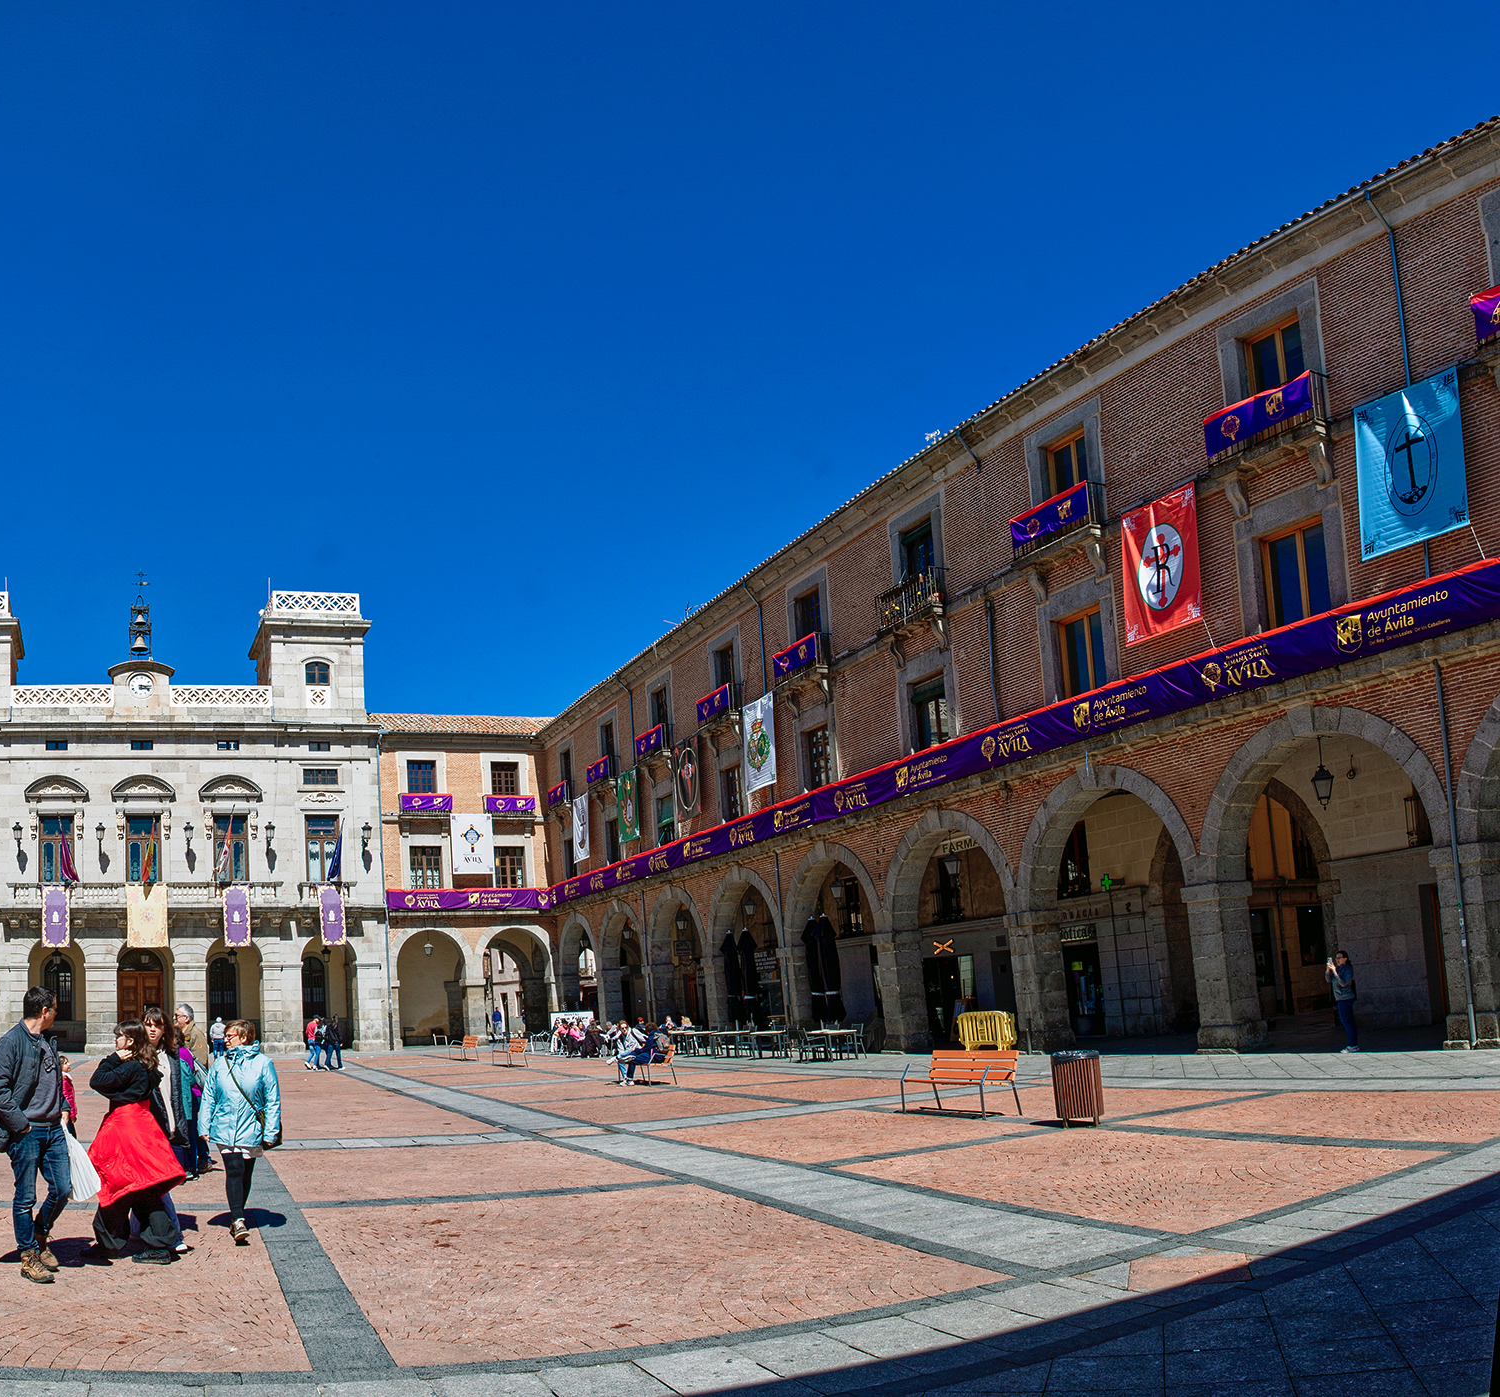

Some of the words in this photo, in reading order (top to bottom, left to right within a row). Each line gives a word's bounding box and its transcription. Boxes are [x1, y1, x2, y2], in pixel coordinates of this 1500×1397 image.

[1151, 543, 1175, 594] R
[1367, 590, 1448, 623] Ayuntamiento
[1367, 625, 1381, 638] de
[1384, 615, 1414, 633] Ávila
[1427, 618, 1451, 629] Caballeros
[1223, 655, 1248, 668] SEMANA
[1248, 648, 1270, 660] SANTA
[1226, 659, 1276, 686] ÁVILA
[1093, 686, 1147, 711] Ayuntamiento
[1093, 711, 1104, 722] de
[1105, 704, 1126, 719] Ávila
[998, 736, 1033, 757] ÁVILA
[910, 755, 947, 773] Ayuntamiento
[910, 775, 916, 783] de
[917, 769, 932, 781] Ávila
[845, 792, 869, 809] ÁVILA
